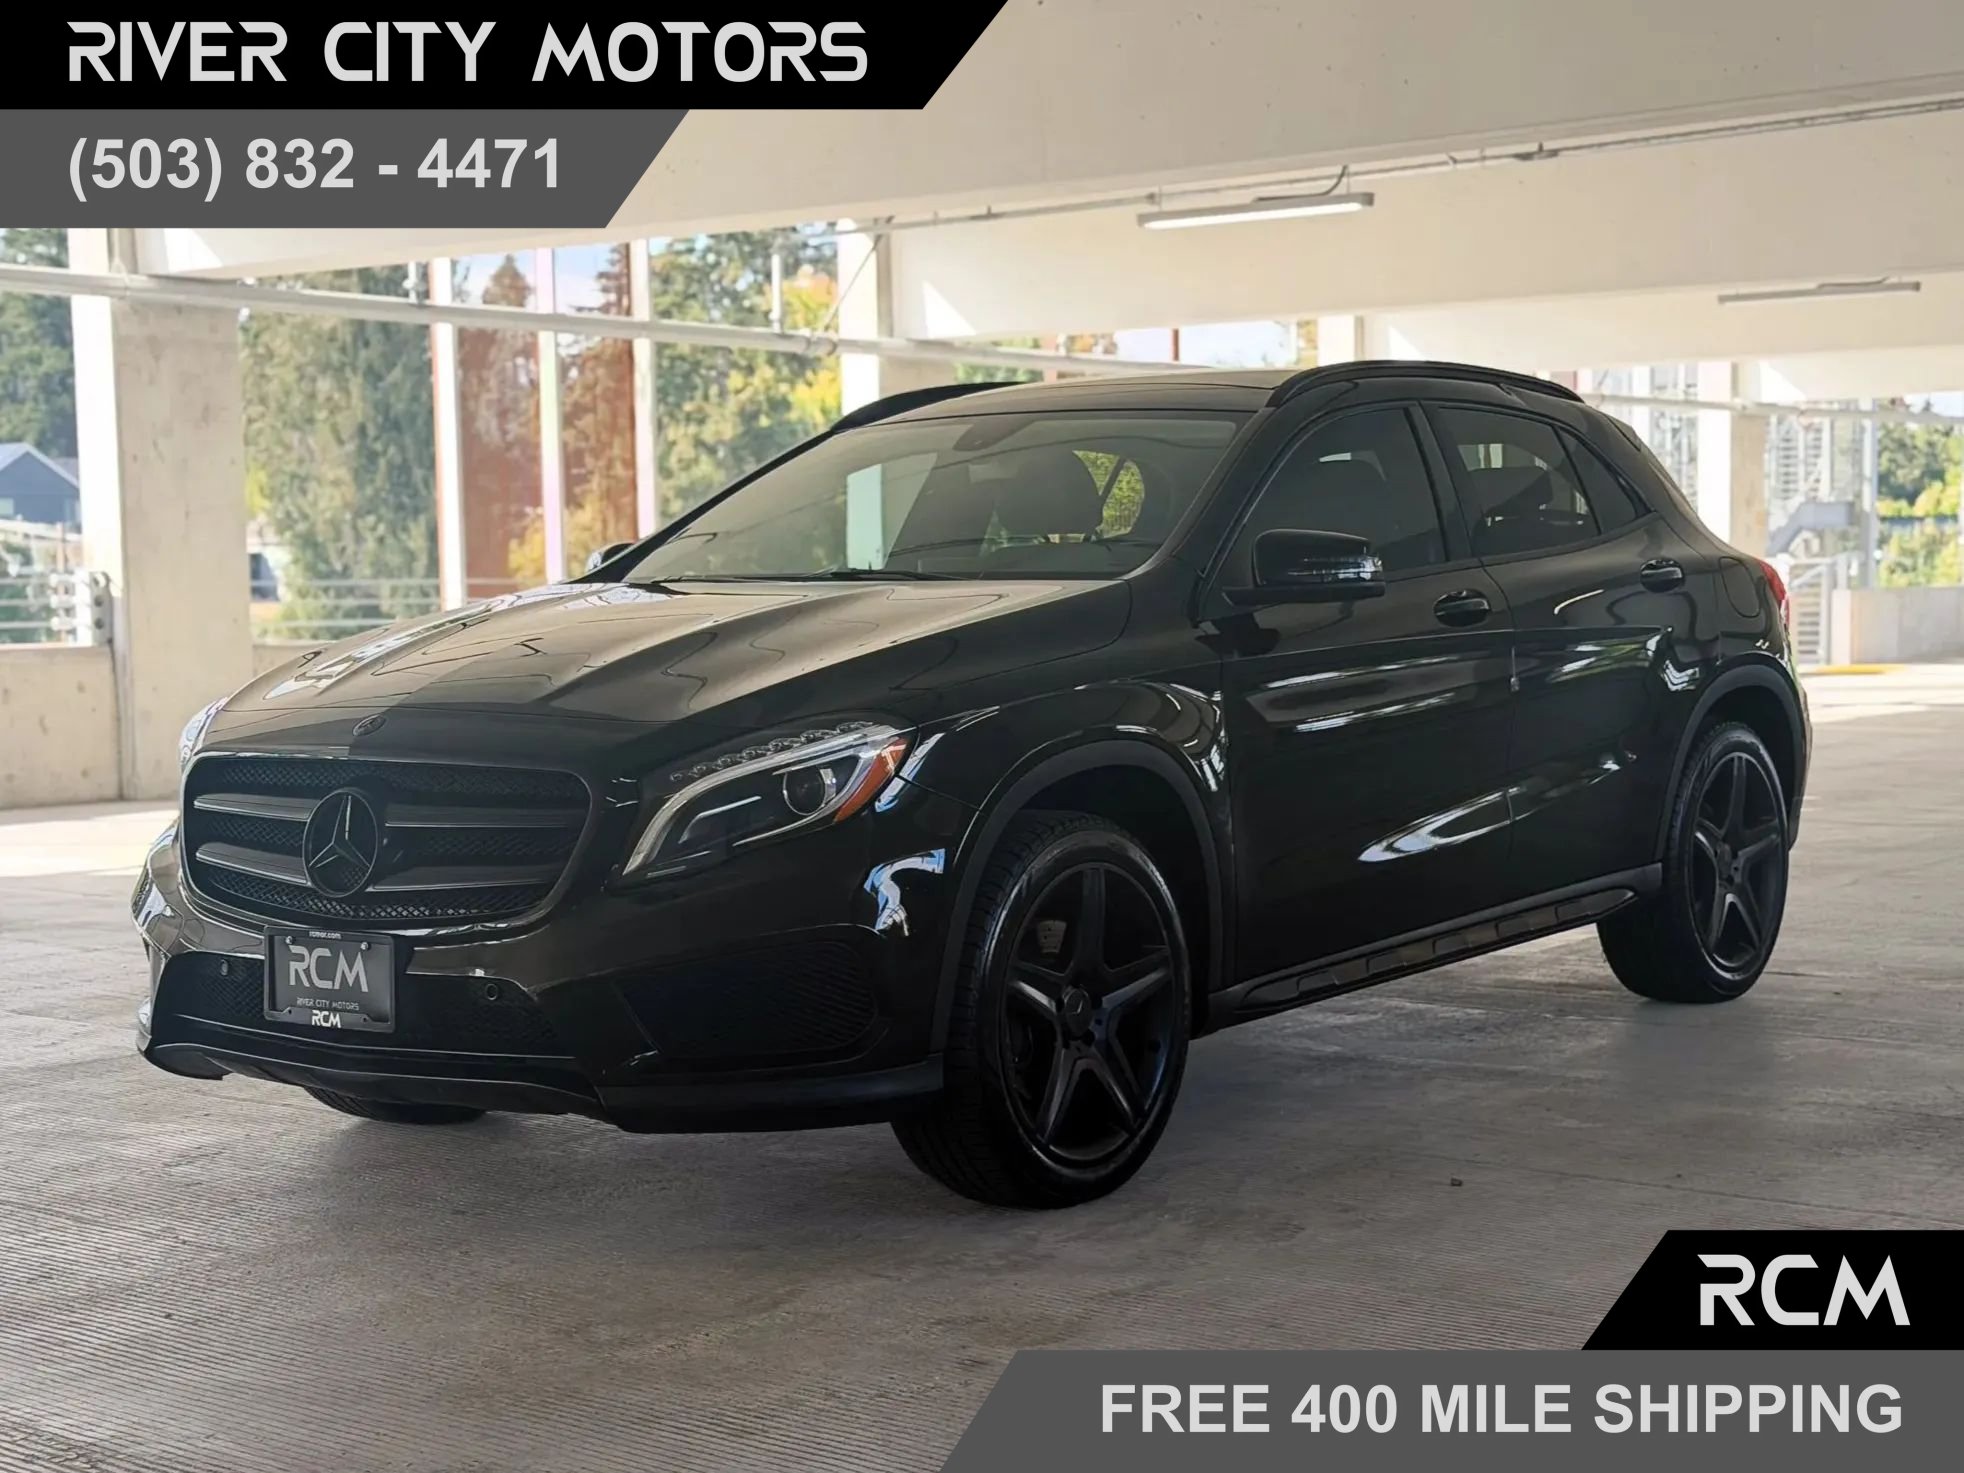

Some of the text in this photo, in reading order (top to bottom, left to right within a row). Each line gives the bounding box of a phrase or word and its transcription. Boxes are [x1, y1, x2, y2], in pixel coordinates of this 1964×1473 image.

[288, 944, 369, 993] RCM
[296, 997, 360, 1011] RIVER CITY MOTORS
[311, 1009, 342, 1029] RCM
